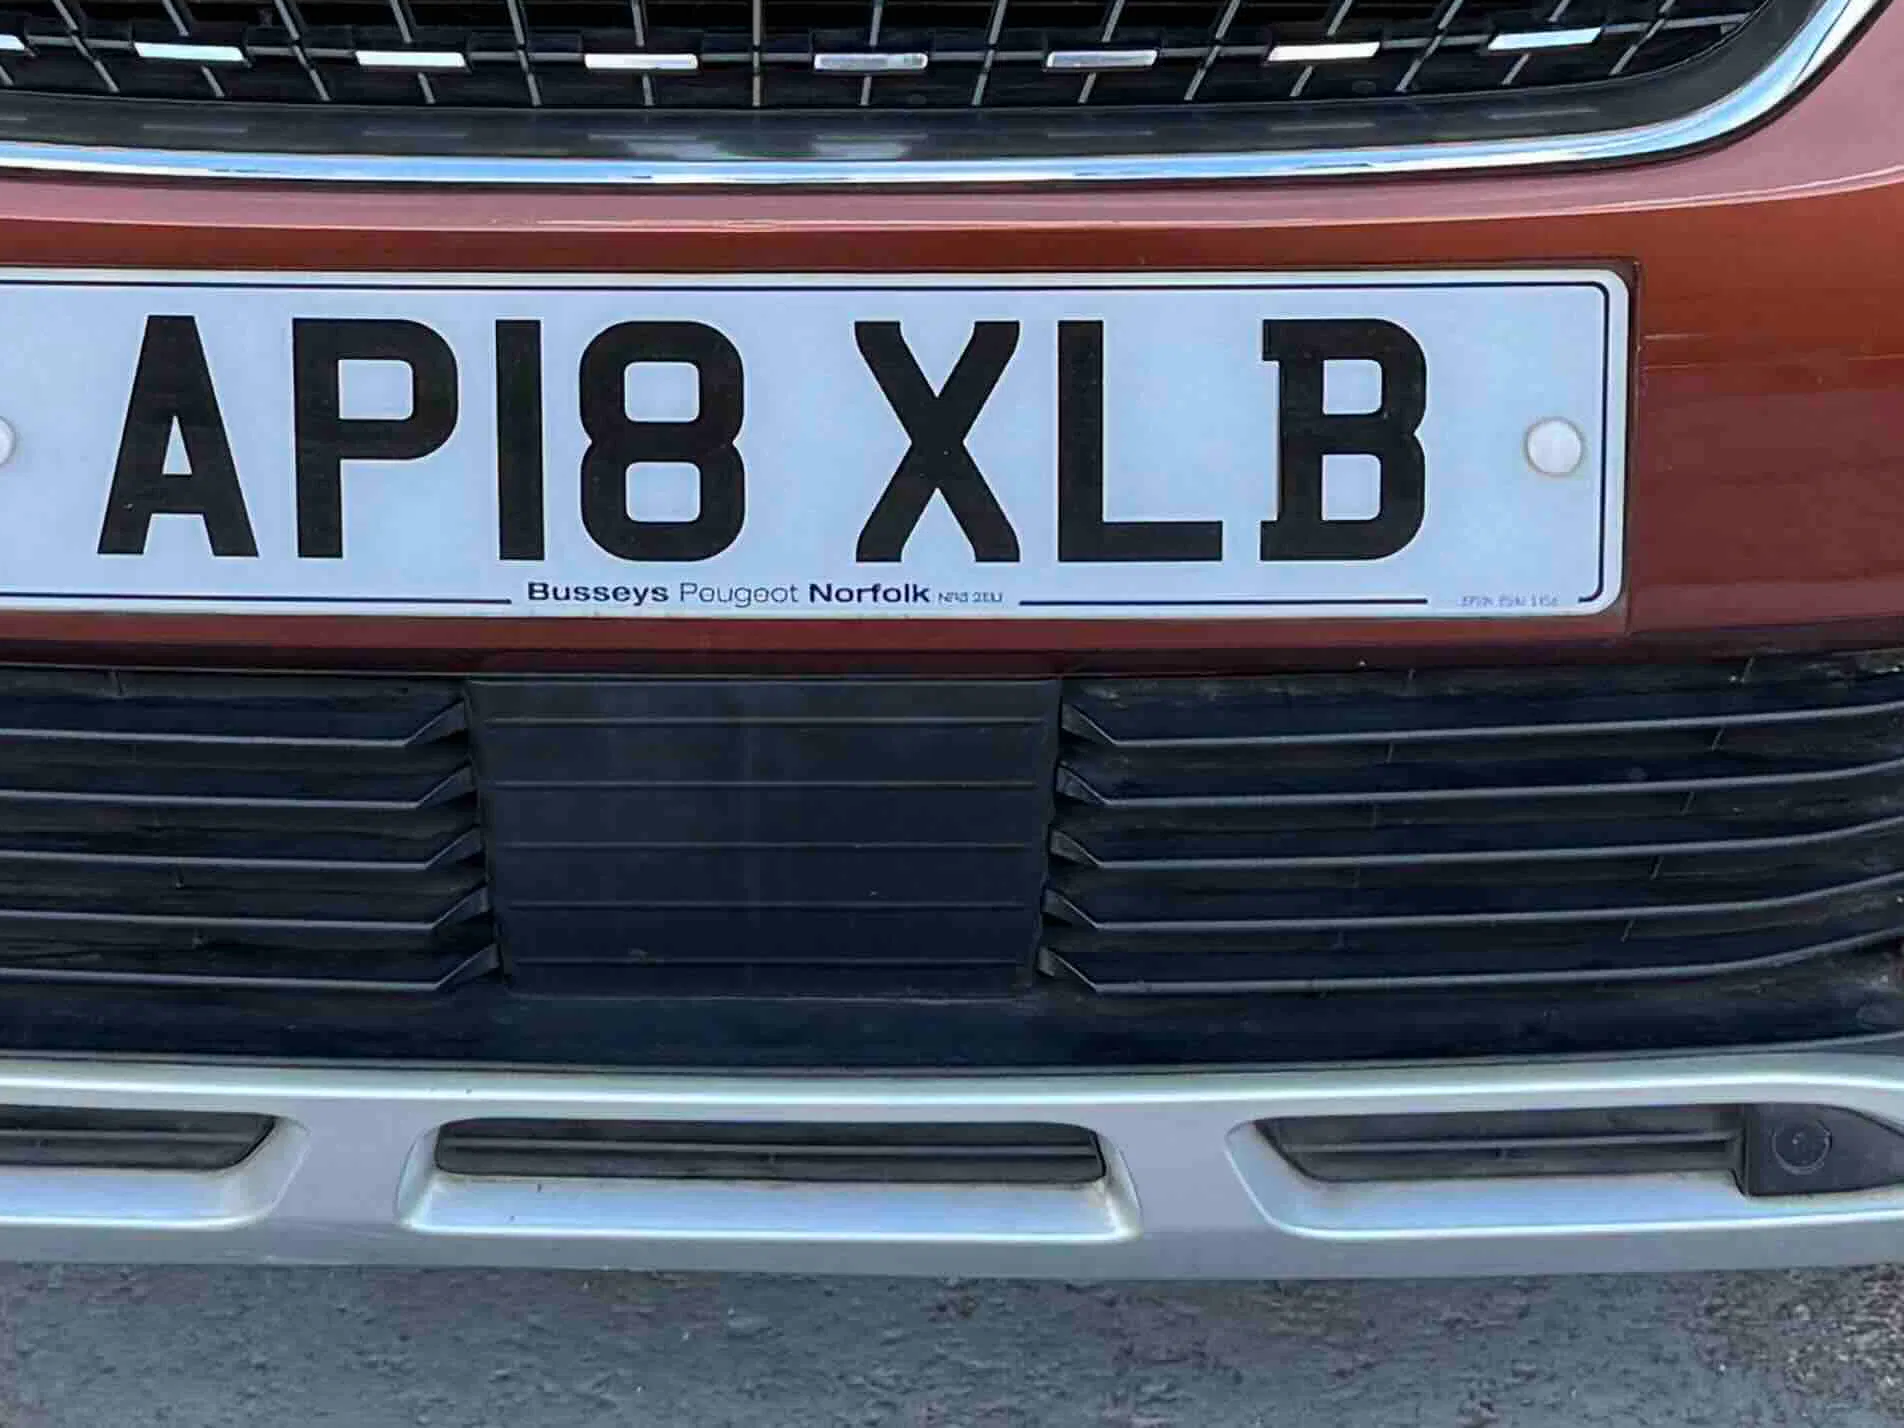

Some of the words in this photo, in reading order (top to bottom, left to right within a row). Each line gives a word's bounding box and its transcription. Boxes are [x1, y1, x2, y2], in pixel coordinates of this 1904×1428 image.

[96, 314, 746, 563] AP18
[853, 318, 1427, 563] XLB
[527, 581, 669, 605] Busseys
[679, 582, 799, 608] Peugeot
[809, 582, 930, 604] Norfolk
